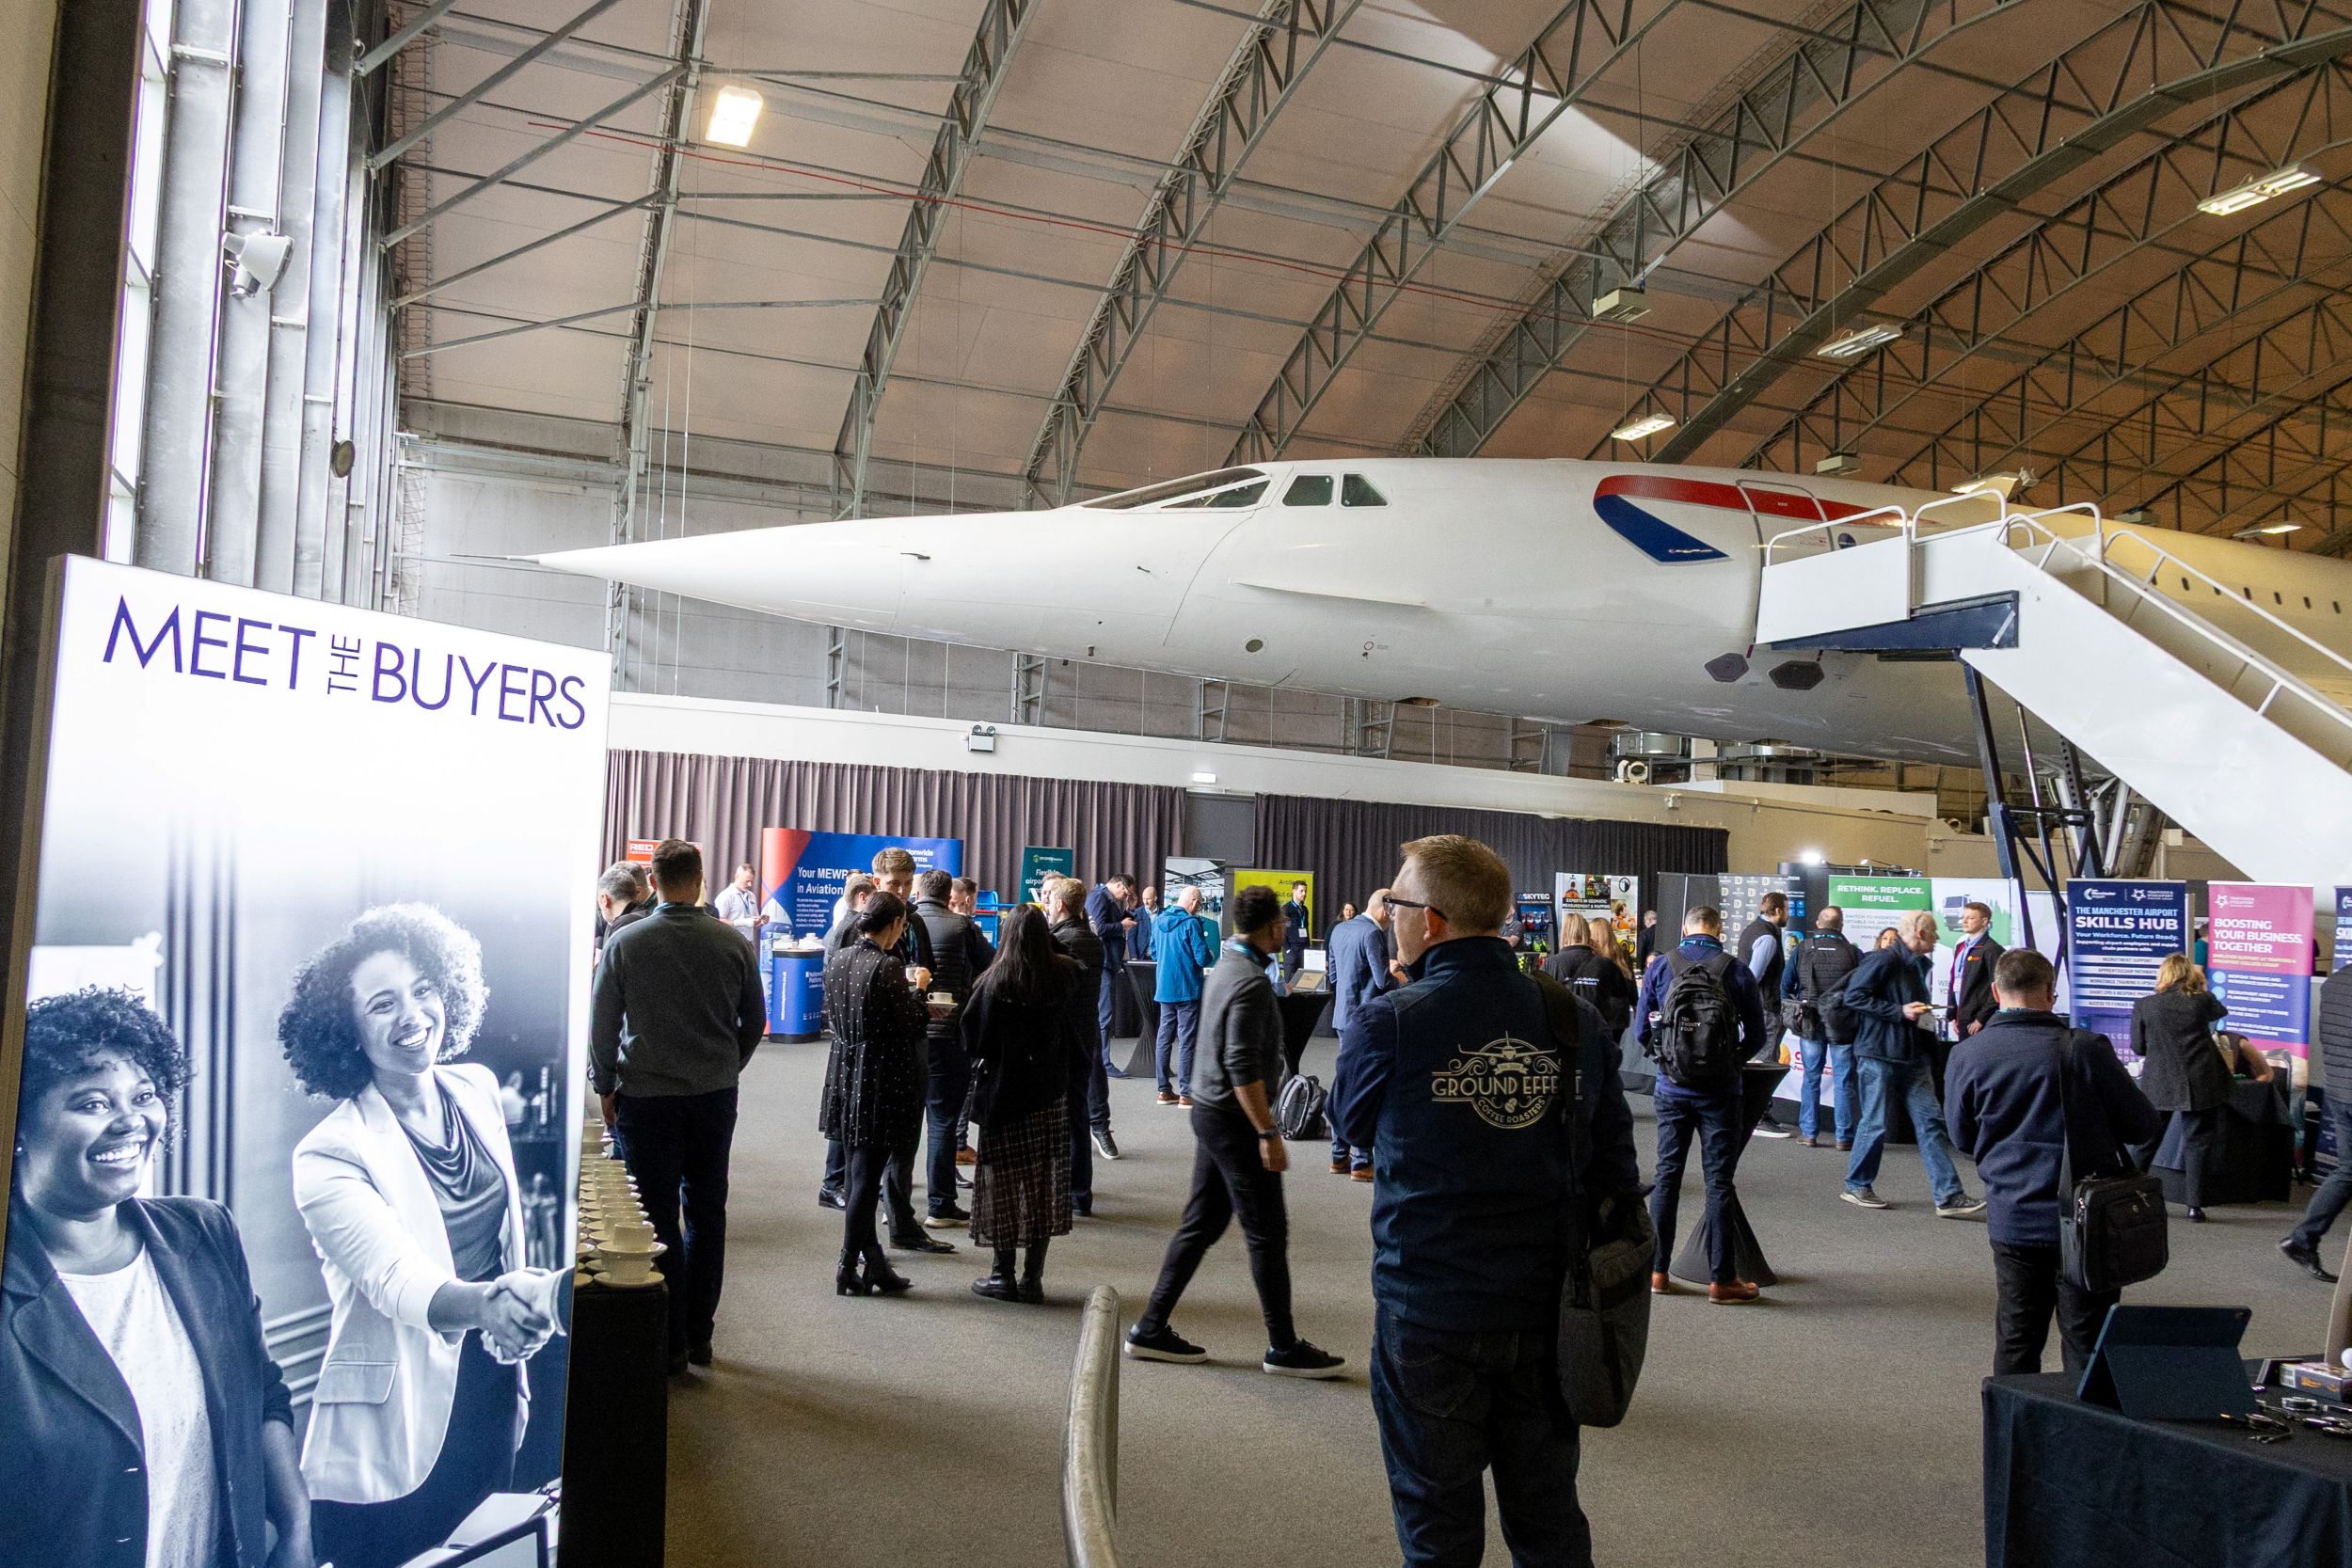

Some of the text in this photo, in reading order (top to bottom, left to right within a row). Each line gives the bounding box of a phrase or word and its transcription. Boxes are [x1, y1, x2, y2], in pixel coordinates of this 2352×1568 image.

[103, 594, 586, 730] MEET THE BUYERS
[629, 843, 654, 851] RED
[798, 866, 815, 879] Your
[797, 883, 844, 895] in Aviation
[2091, 907, 2144, 915] MANCHESTER
[2075, 916, 2179, 930] SKILLS HUB
[2214, 918, 2272, 929] BOOSTING
[2214, 929, 2246, 940] YOUR
[2213, 941, 2273, 953] TOGETHER
[1432, 1078, 1518, 1097] GROUND
[1478, 1099, 1546, 1123] COFFEE ROASTERS
